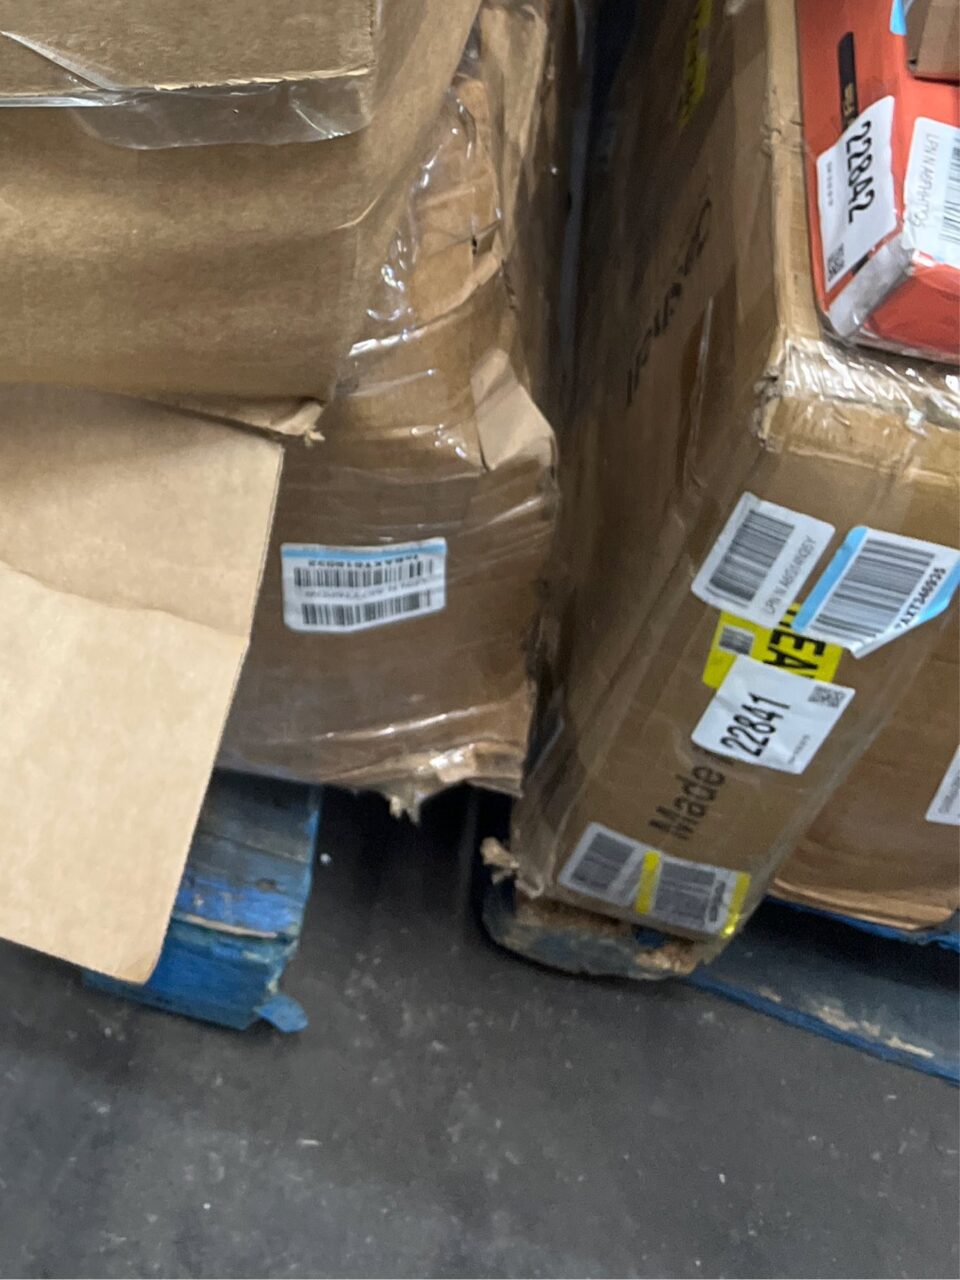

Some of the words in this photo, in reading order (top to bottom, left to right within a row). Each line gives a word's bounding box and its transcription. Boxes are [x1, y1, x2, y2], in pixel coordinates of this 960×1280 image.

[846, 120, 876, 224] 22842
[720, 691, 791, 758] 22841
[649, 765, 727, 840] Made
